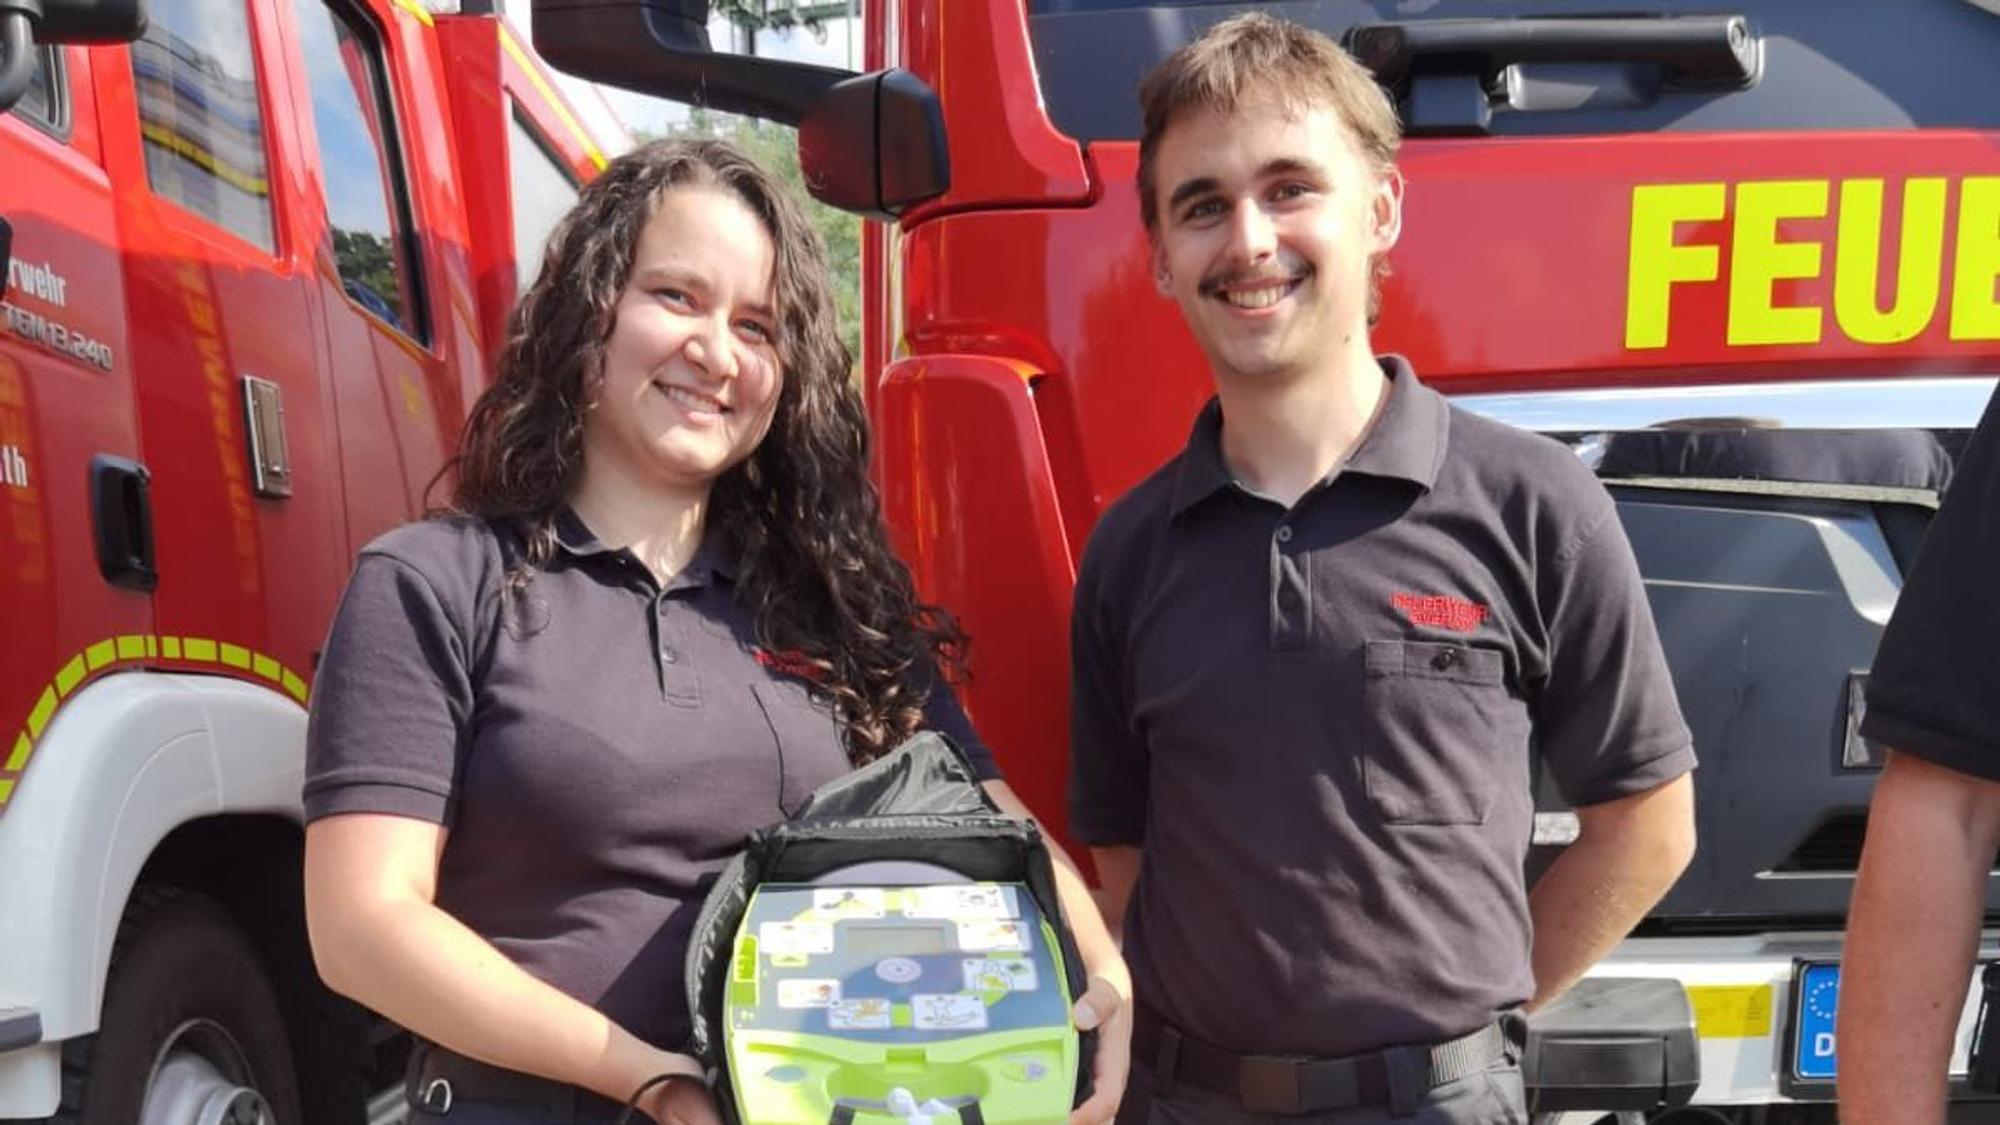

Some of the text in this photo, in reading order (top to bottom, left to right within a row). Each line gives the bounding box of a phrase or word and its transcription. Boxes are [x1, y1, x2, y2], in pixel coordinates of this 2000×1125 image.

[8, 257, 66, 307] rwehr
[0, 445, 28, 487] th
[1815, 1033, 1836, 1057] D
